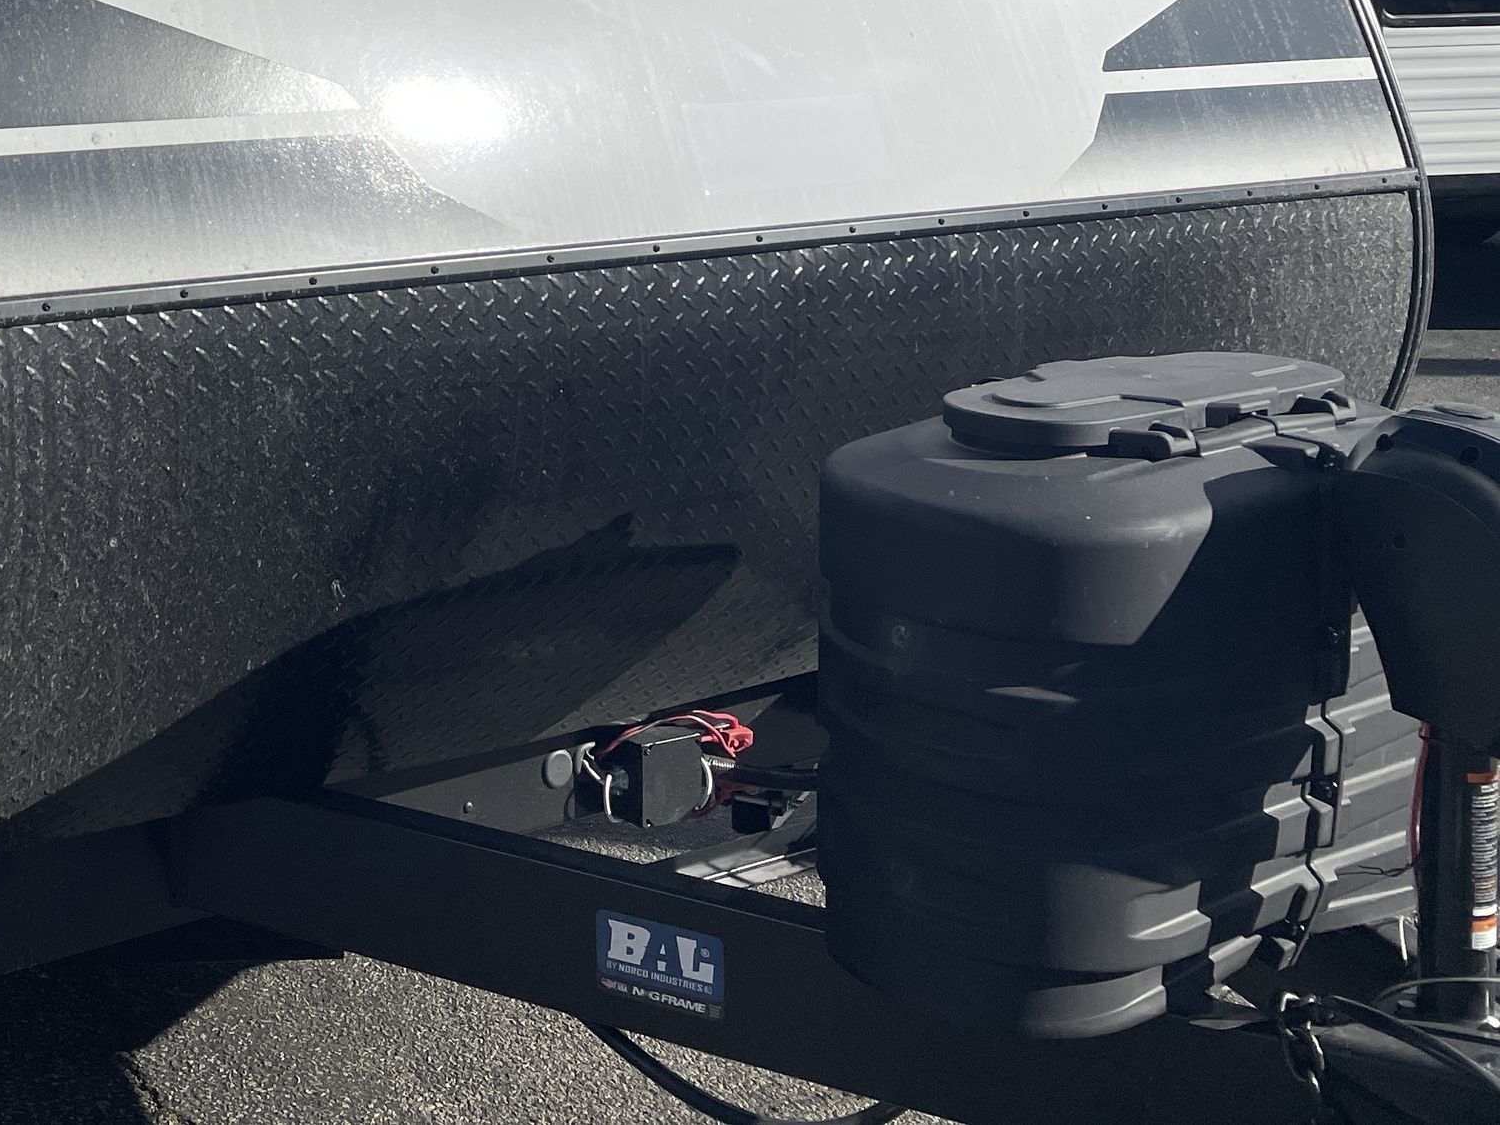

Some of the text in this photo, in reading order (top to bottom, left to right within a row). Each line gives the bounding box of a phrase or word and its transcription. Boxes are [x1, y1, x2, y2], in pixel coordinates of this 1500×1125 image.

[606, 960, 704, 993] BY NORCO INDUSTRIES
[661, 994, 707, 1014] FRAME
